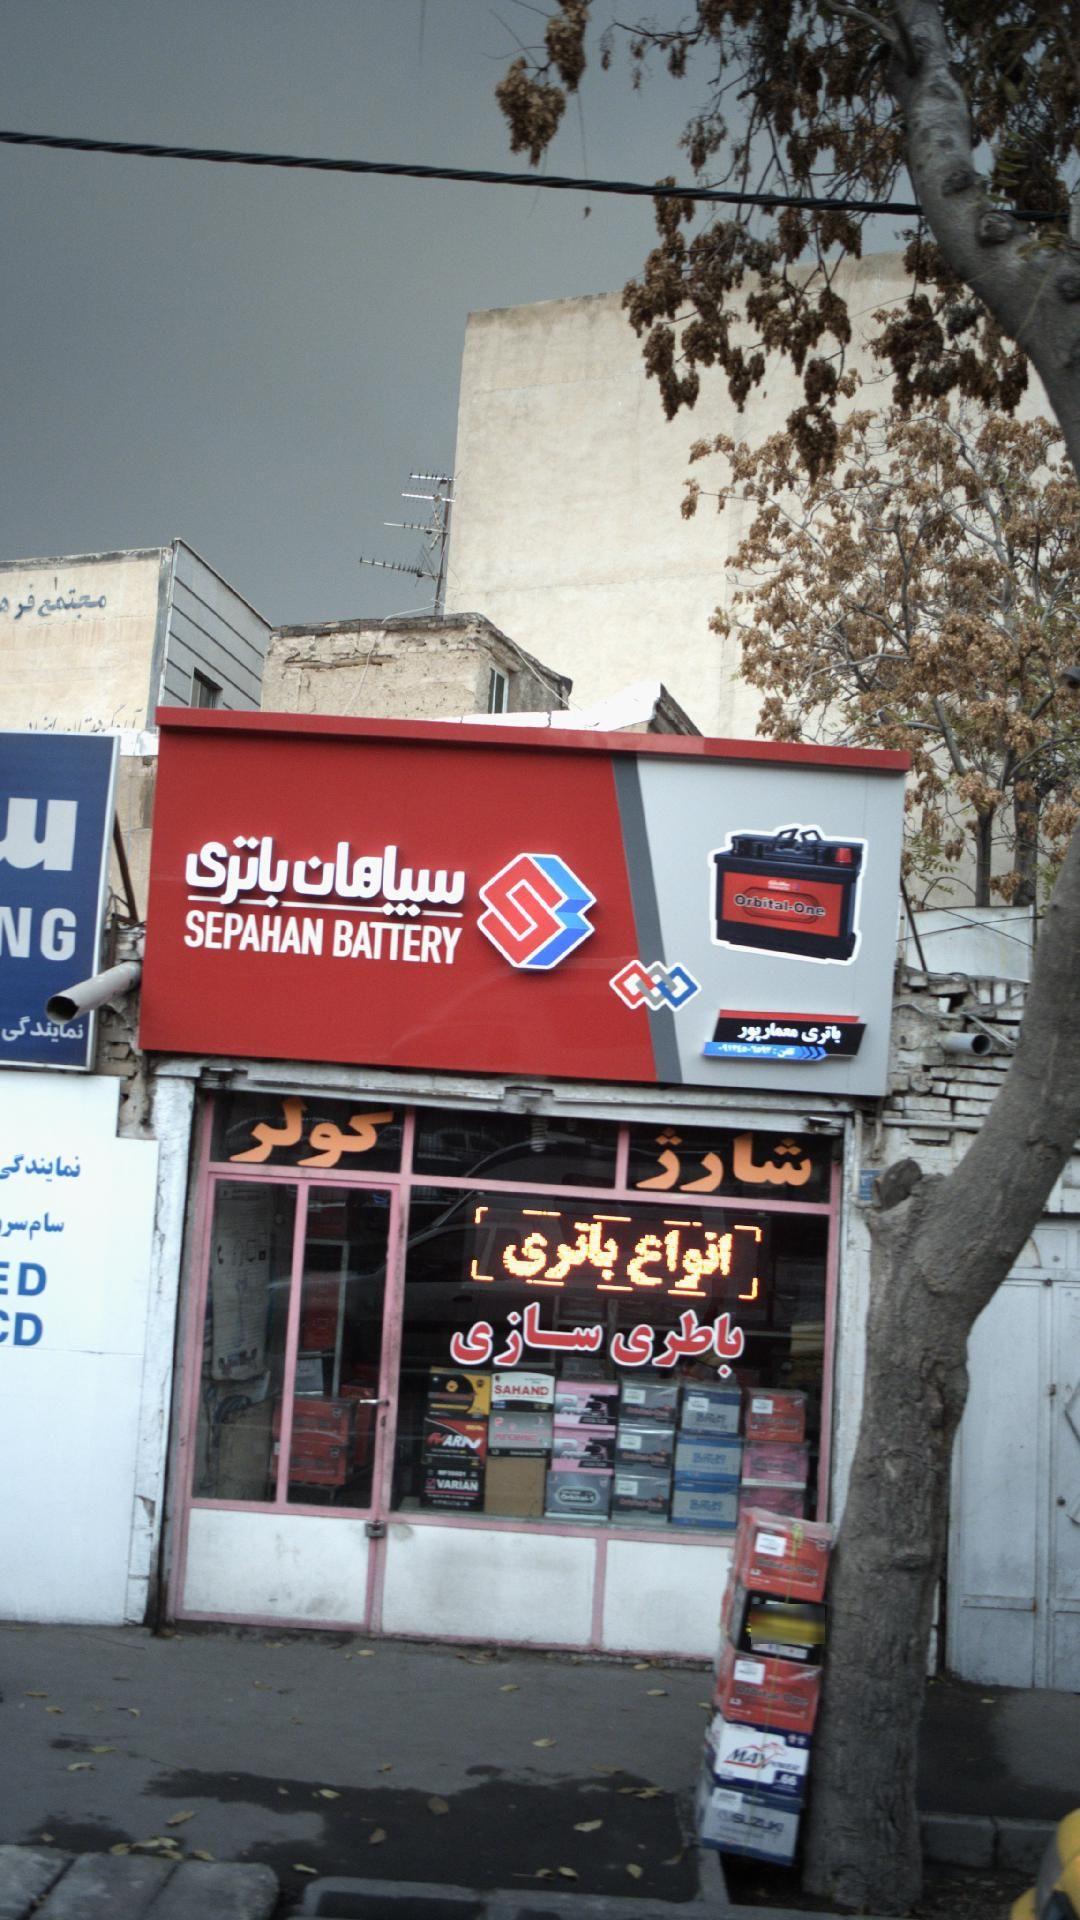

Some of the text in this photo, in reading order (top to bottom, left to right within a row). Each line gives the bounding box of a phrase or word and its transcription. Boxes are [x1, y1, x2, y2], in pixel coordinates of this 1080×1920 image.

[186, 835, 465, 916] سپاهان باتری
[733, 894, 826, 917] Orbital-One
[184, 910, 463, 965] SEPAHAN BATTERY
[1, 1015, 84, 1042] نمایندگی
[801, 1025, 842, 1044] باتری
[230, 1097, 395, 1168] کولر
[635, 1128, 812, 1193] شارژ
[503, 1222, 733, 1289] انواع باتری
[450, 1302, 744, 1378] باطری سازی
[494, 1385, 549, 1395] SAHAND
[436, 1480, 479, 1491] VARIAN
